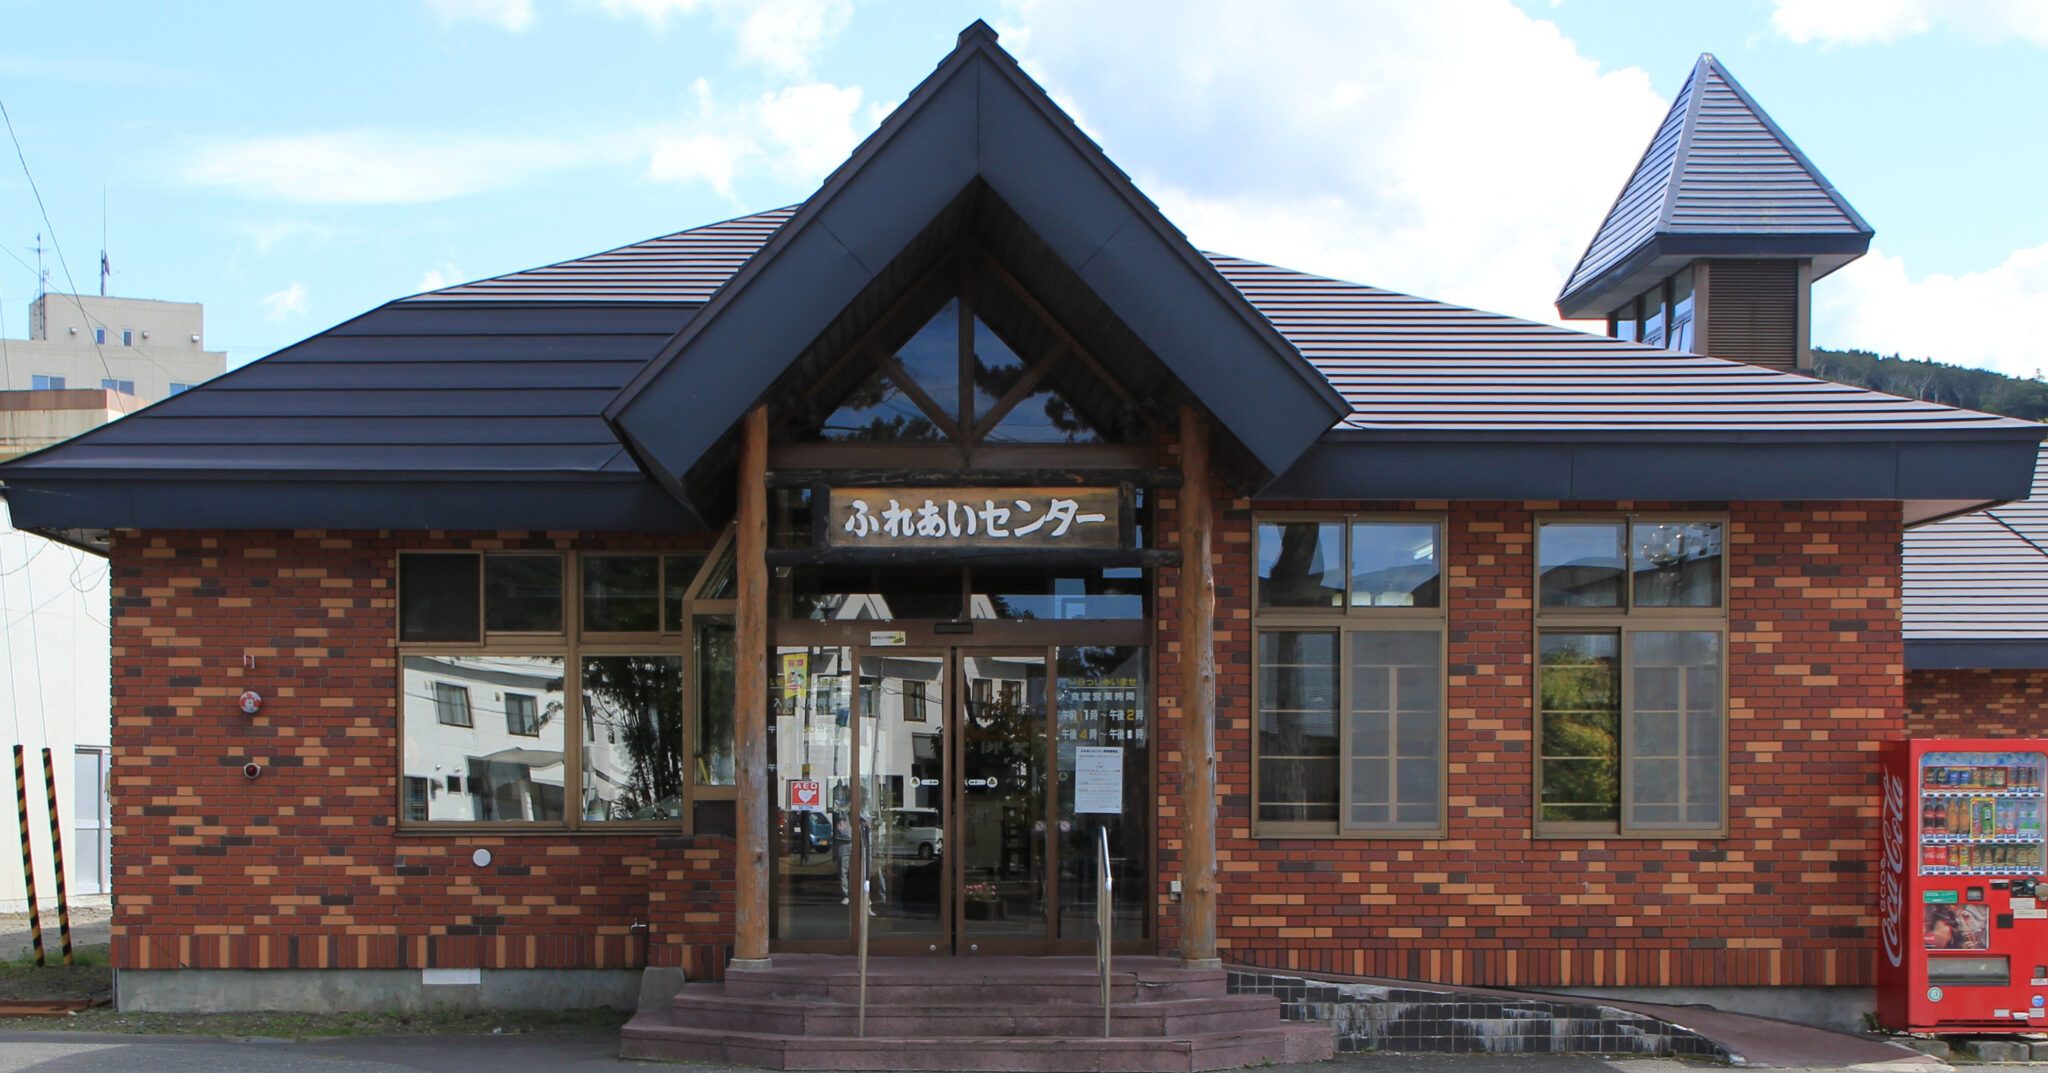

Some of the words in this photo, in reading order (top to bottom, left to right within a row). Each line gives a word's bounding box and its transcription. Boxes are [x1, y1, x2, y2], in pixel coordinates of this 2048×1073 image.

[844, 499, 1106, 538] ふれあいセンター
[1881, 763, 1904, 967] Coca-Cola
